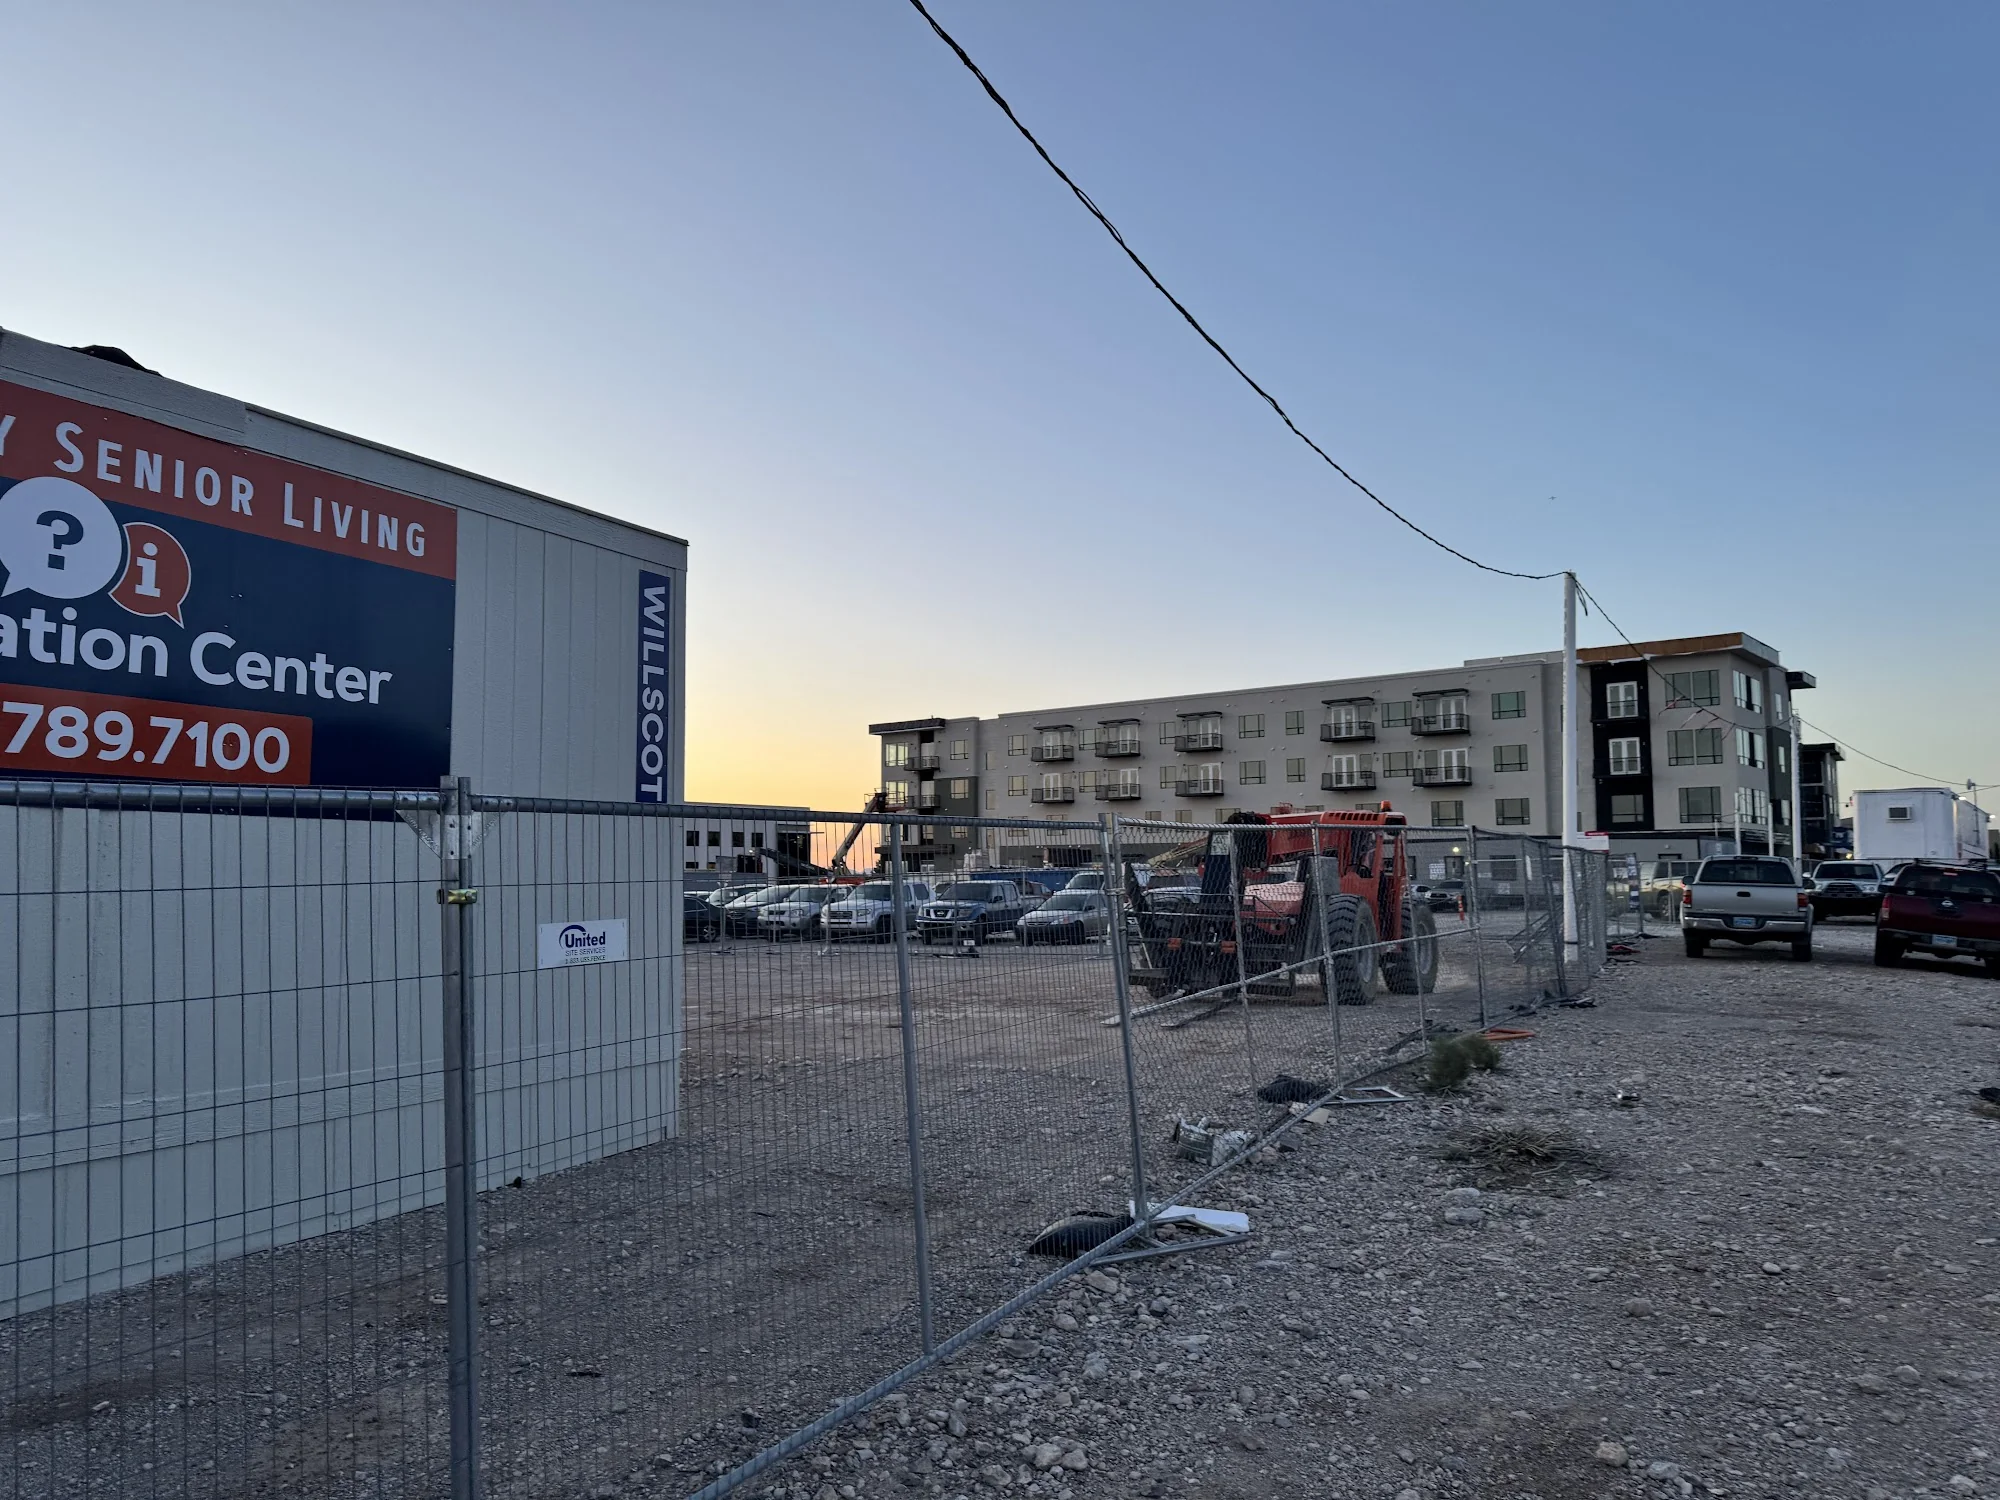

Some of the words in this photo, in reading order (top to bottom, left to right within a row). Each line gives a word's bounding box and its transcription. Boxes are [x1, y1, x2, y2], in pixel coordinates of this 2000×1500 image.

[53, 421, 254, 516] SENIOR
[283, 482, 426, 557] LIVING
[190, 632, 393, 705] Center
[640, 586, 666, 802] WILLSCOT
[2, 701, 290, 774] 789.7100
[565, 931, 606, 948] United
[579, 947, 606, 955] SERVICES
